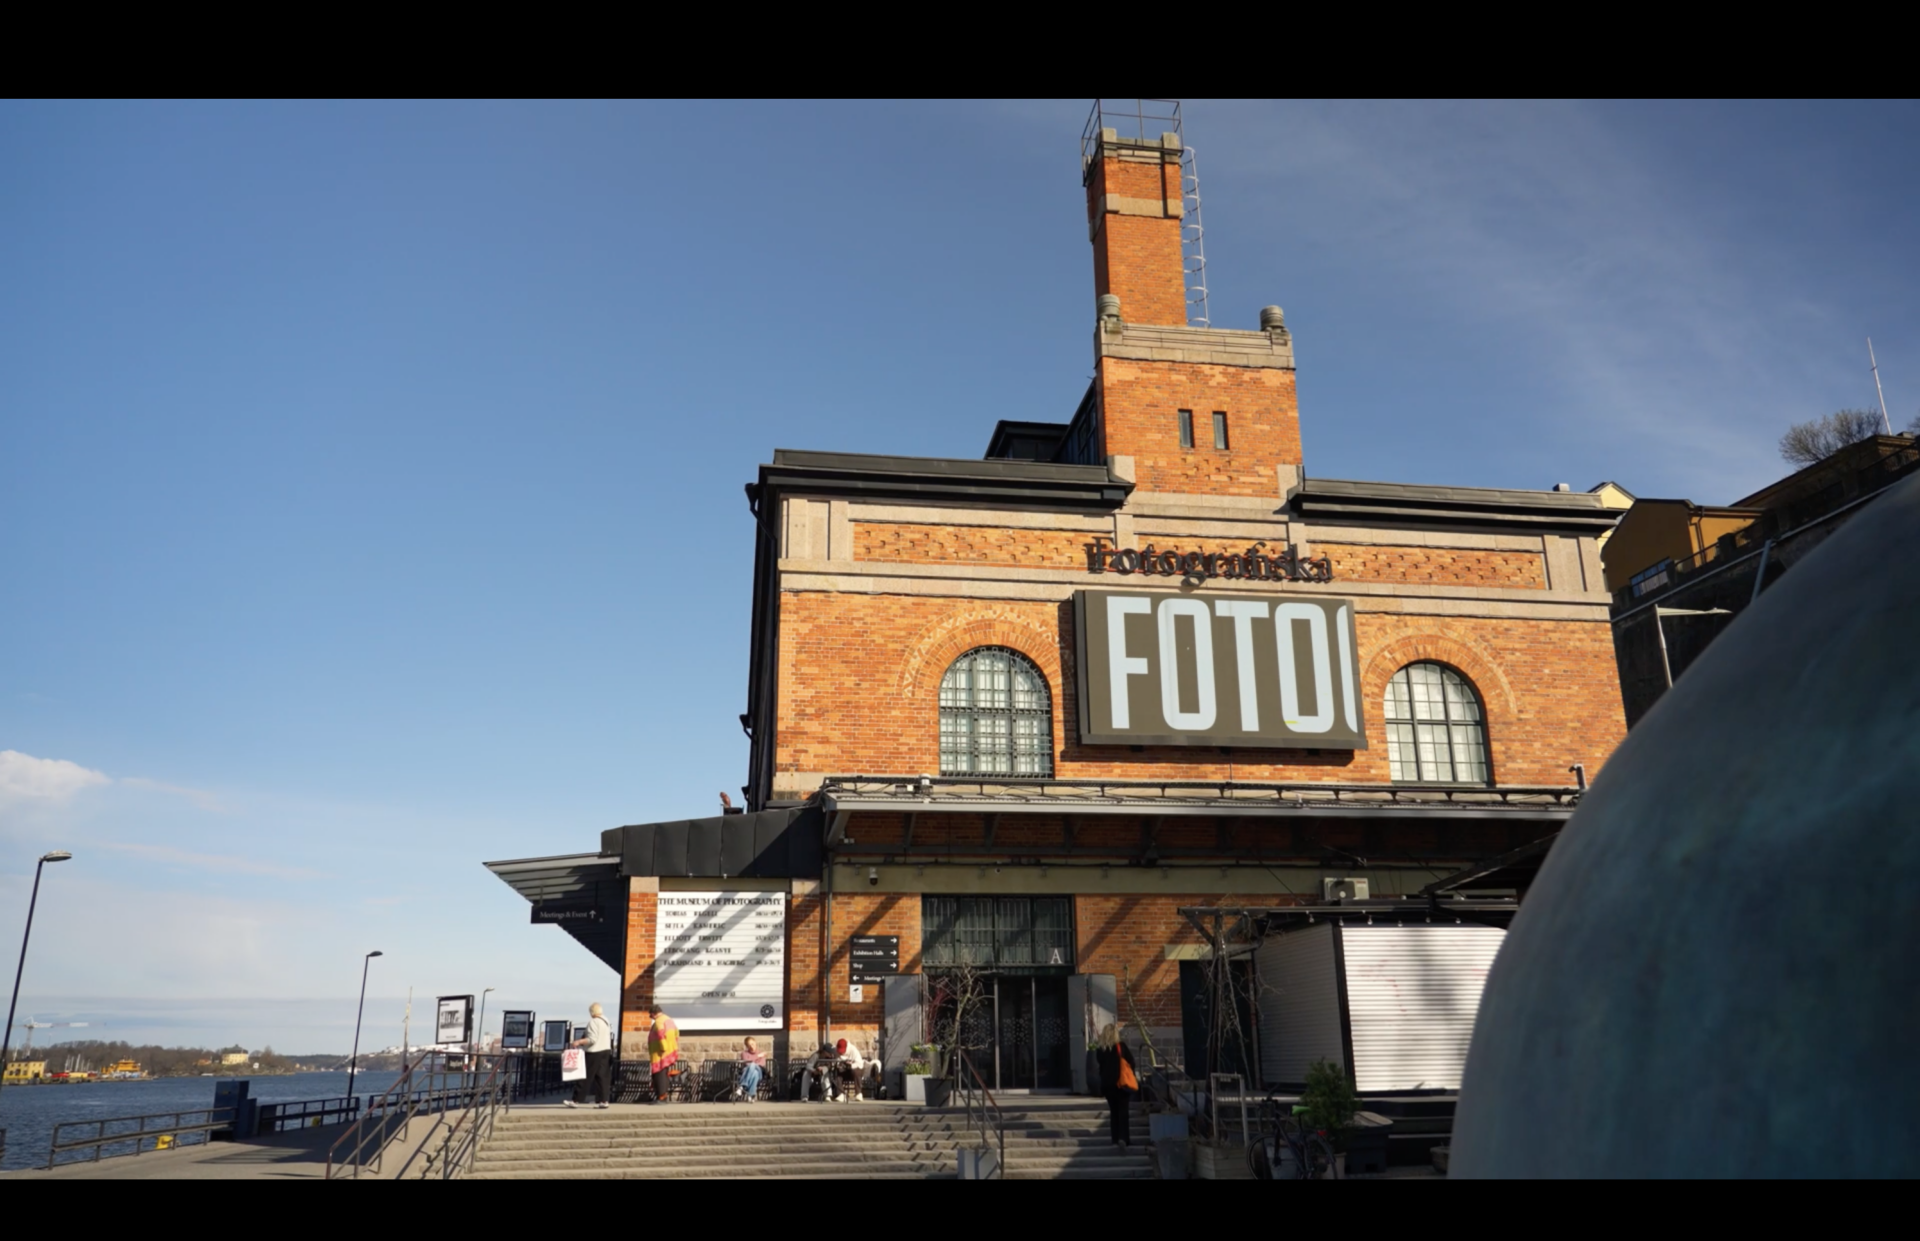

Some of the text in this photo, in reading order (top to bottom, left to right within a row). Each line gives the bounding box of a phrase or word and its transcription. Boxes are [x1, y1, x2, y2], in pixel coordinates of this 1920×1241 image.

[1087, 536, 1334, 587] Fotografiska
[540, 911, 565, 920] Meetings
[1050, 948, 1063, 964] A
